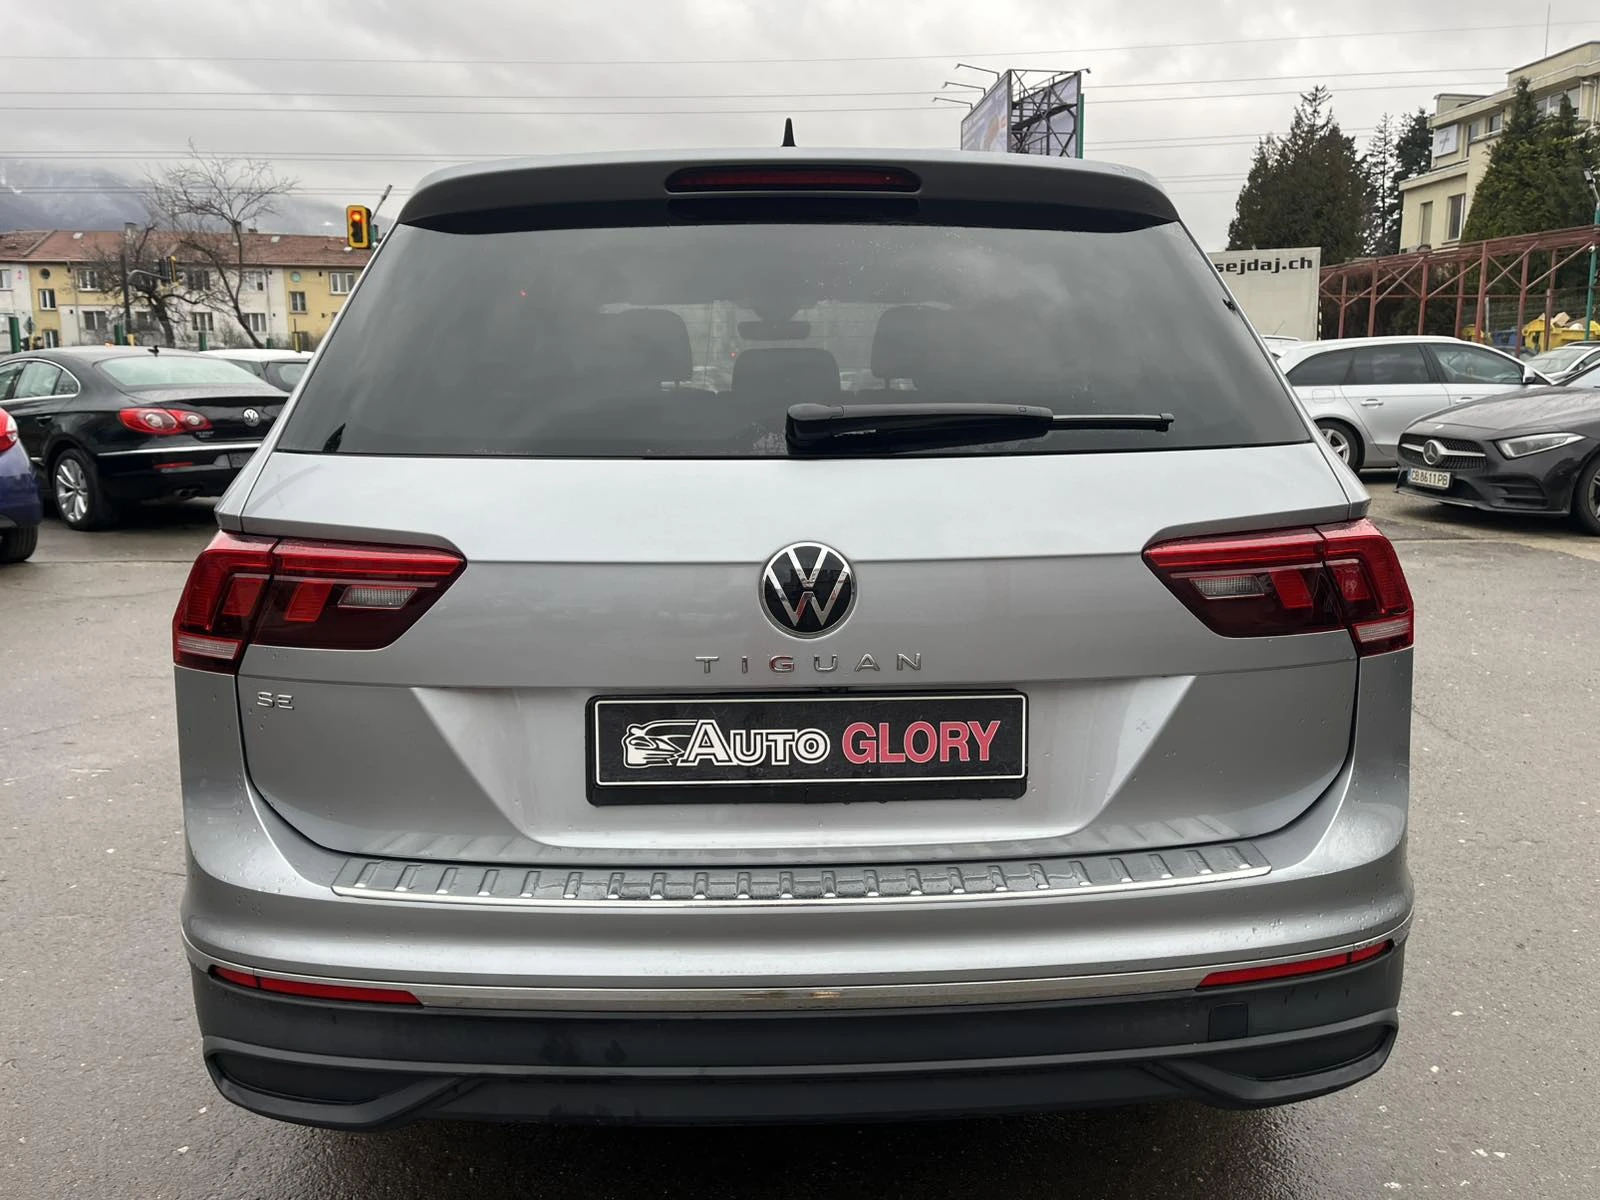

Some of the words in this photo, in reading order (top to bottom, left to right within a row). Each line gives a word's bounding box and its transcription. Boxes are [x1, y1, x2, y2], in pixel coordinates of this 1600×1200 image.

[1214, 257, 1313, 275] sejdaj.ch
[759, 541, 857, 639] VW
[695, 652, 922, 674] TIGUAN
[257, 691, 294, 710] SE
[676, 719, 831, 767] AUTO
[842, 720, 1000, 764] GLORY
